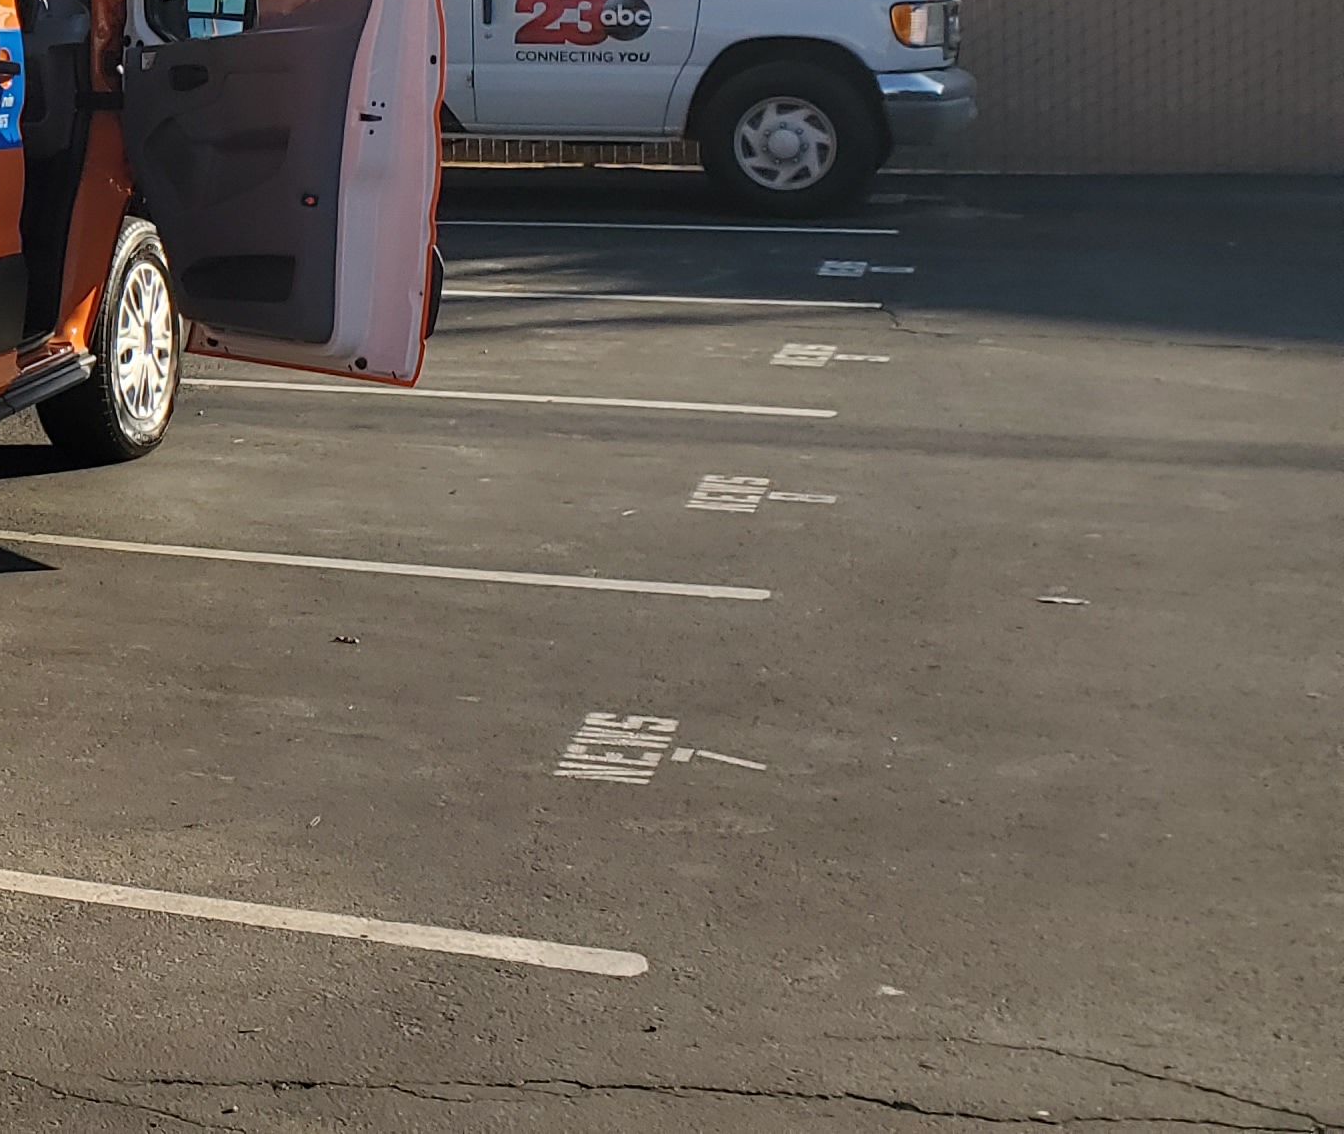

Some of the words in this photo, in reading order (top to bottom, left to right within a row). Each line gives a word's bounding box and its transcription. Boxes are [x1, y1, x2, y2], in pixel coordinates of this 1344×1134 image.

[600, 4, 652, 27] abc
[515, 51, 614, 63] CONNECTING
[618, 52, 651, 63] YOU
[685, 475, 771, 513] NEWS
[552, 712, 680, 785] NEWS
[670, 746, 768, 772] 7
